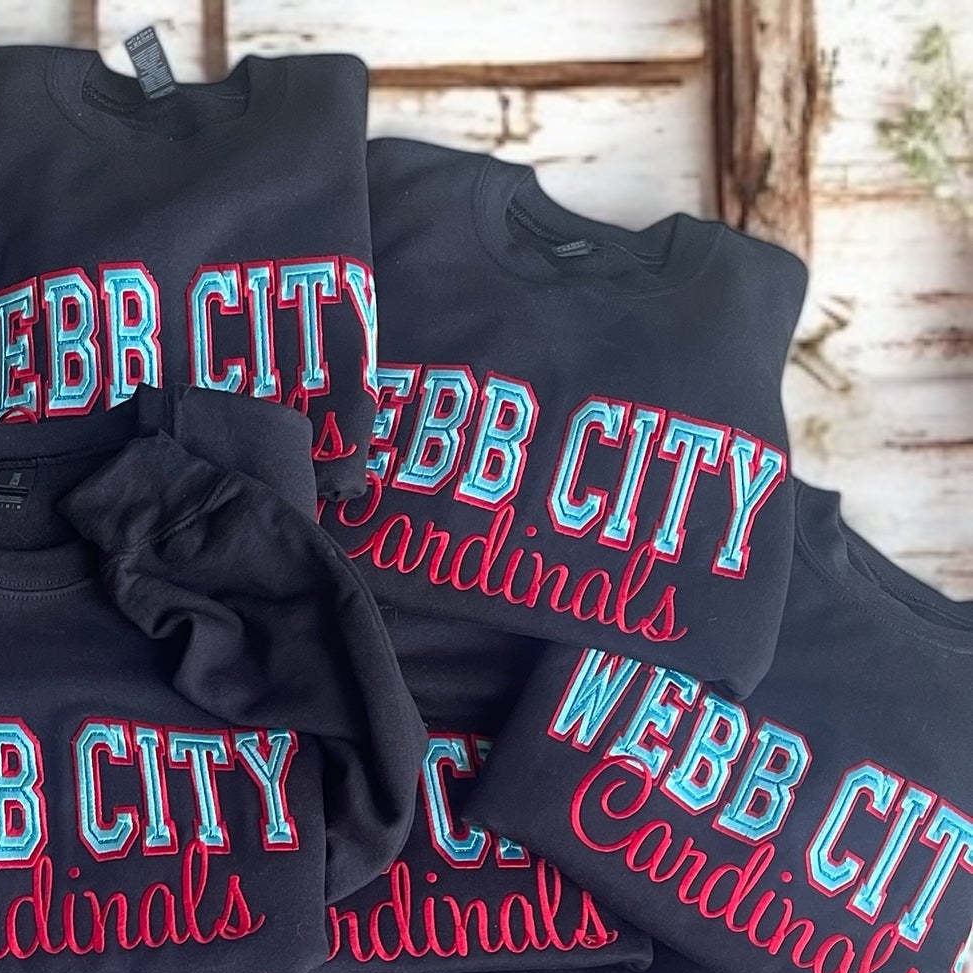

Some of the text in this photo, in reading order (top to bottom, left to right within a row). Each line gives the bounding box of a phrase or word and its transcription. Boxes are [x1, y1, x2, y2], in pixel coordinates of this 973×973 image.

[366, 363, 539, 511] EBB
[547, 393, 790, 580] CITY
[71, 715, 300, 863] CITY
[547, 648, 814, 847] WEBB
[326, 857, 619, 963] rdinals
